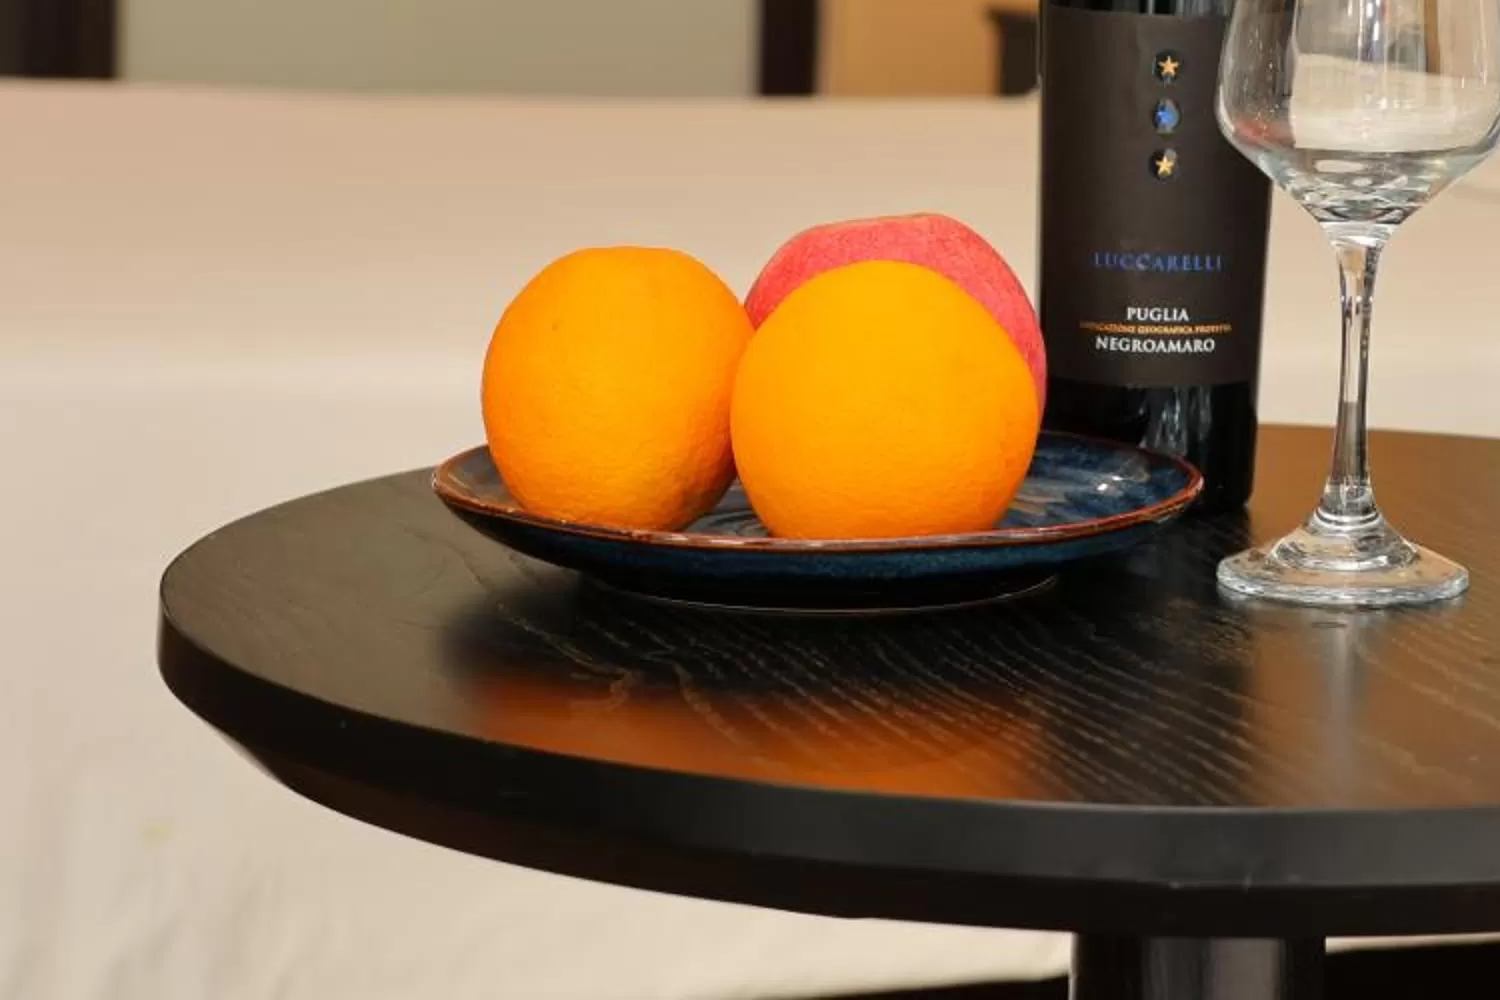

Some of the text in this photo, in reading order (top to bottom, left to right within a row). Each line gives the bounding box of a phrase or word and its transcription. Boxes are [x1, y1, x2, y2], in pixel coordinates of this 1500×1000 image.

[1094, 252, 1222, 272] LUCCARELLI
[1126, 306, 1189, 321] PUGLIA
[1095, 336, 1215, 353] NEGROAMARO
